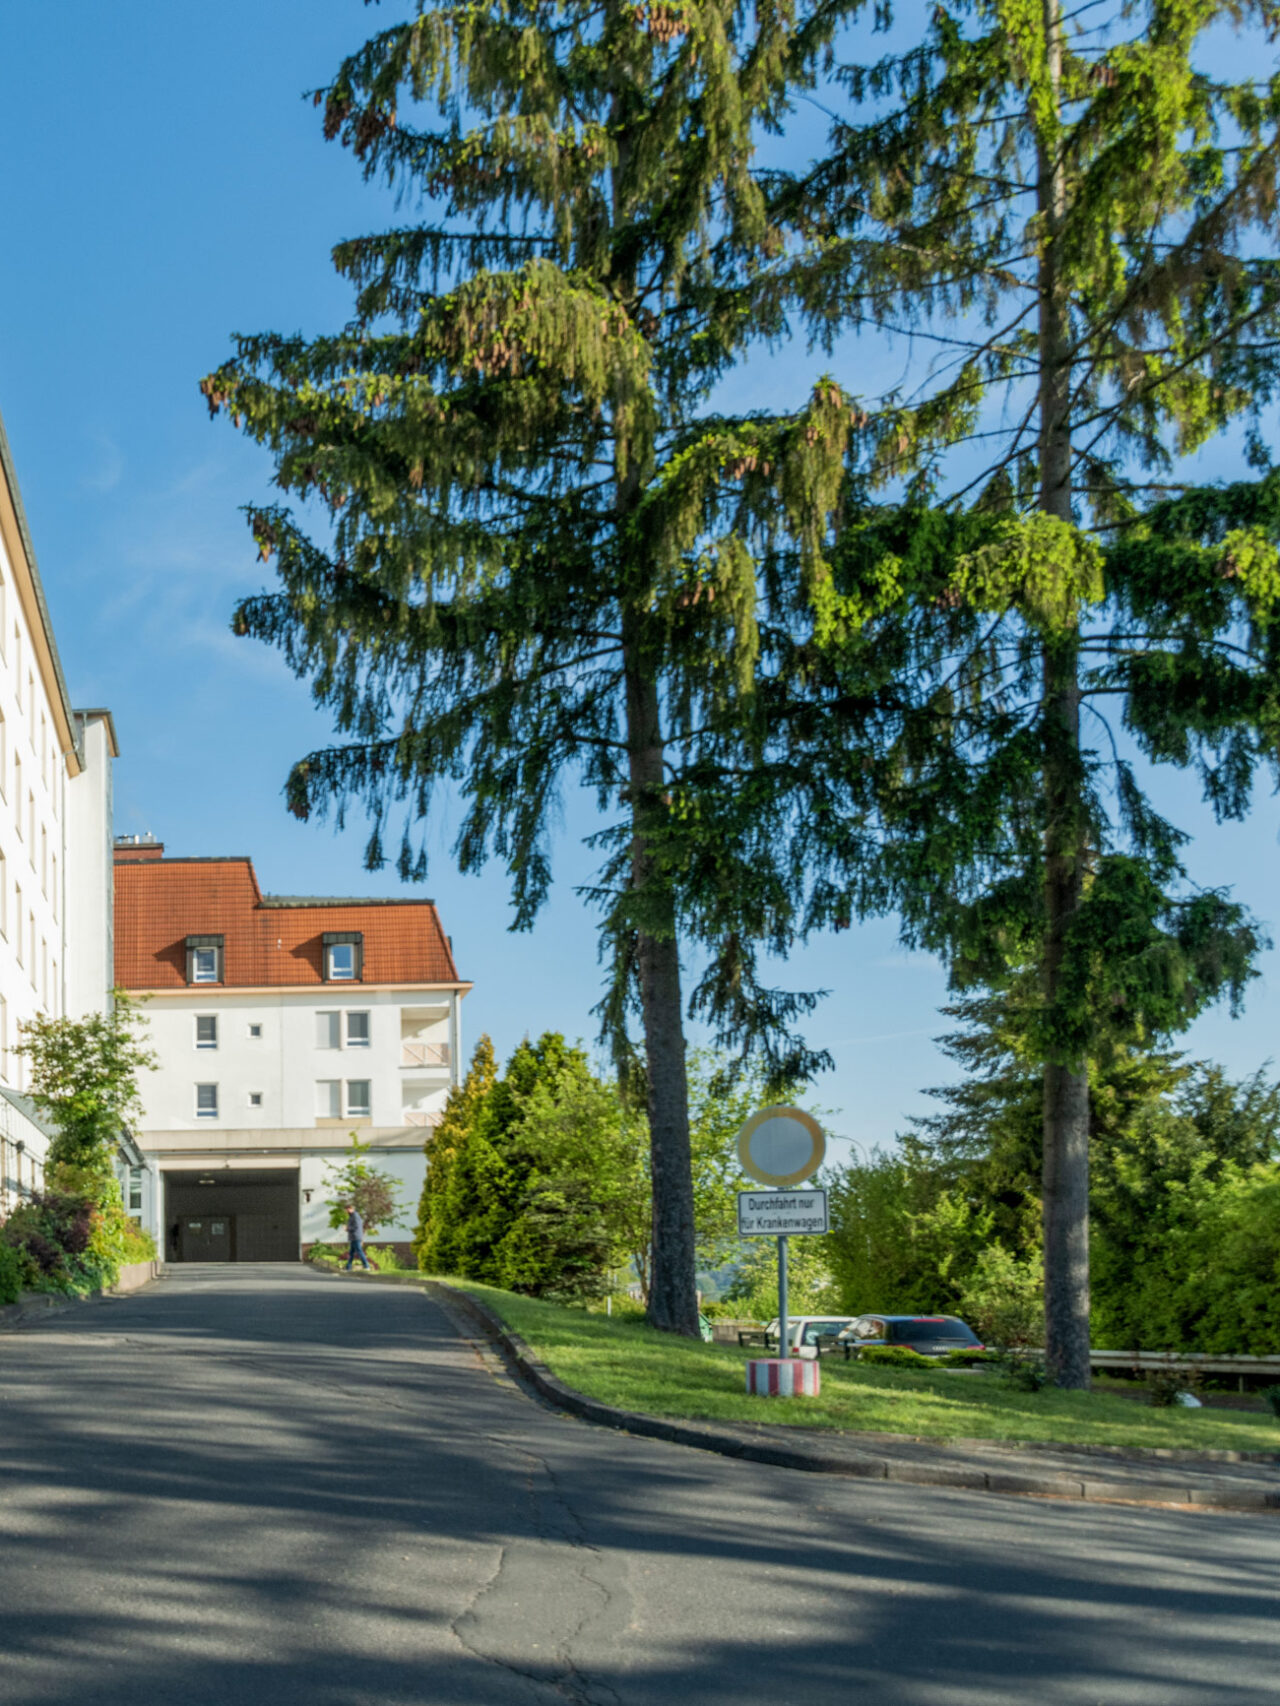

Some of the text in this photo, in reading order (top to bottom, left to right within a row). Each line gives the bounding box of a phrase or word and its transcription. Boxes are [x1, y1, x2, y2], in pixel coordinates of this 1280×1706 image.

[748, 1197, 814, 1210] Durchfahrt nur
[756, 1216, 823, 1231] Krankenwagen
